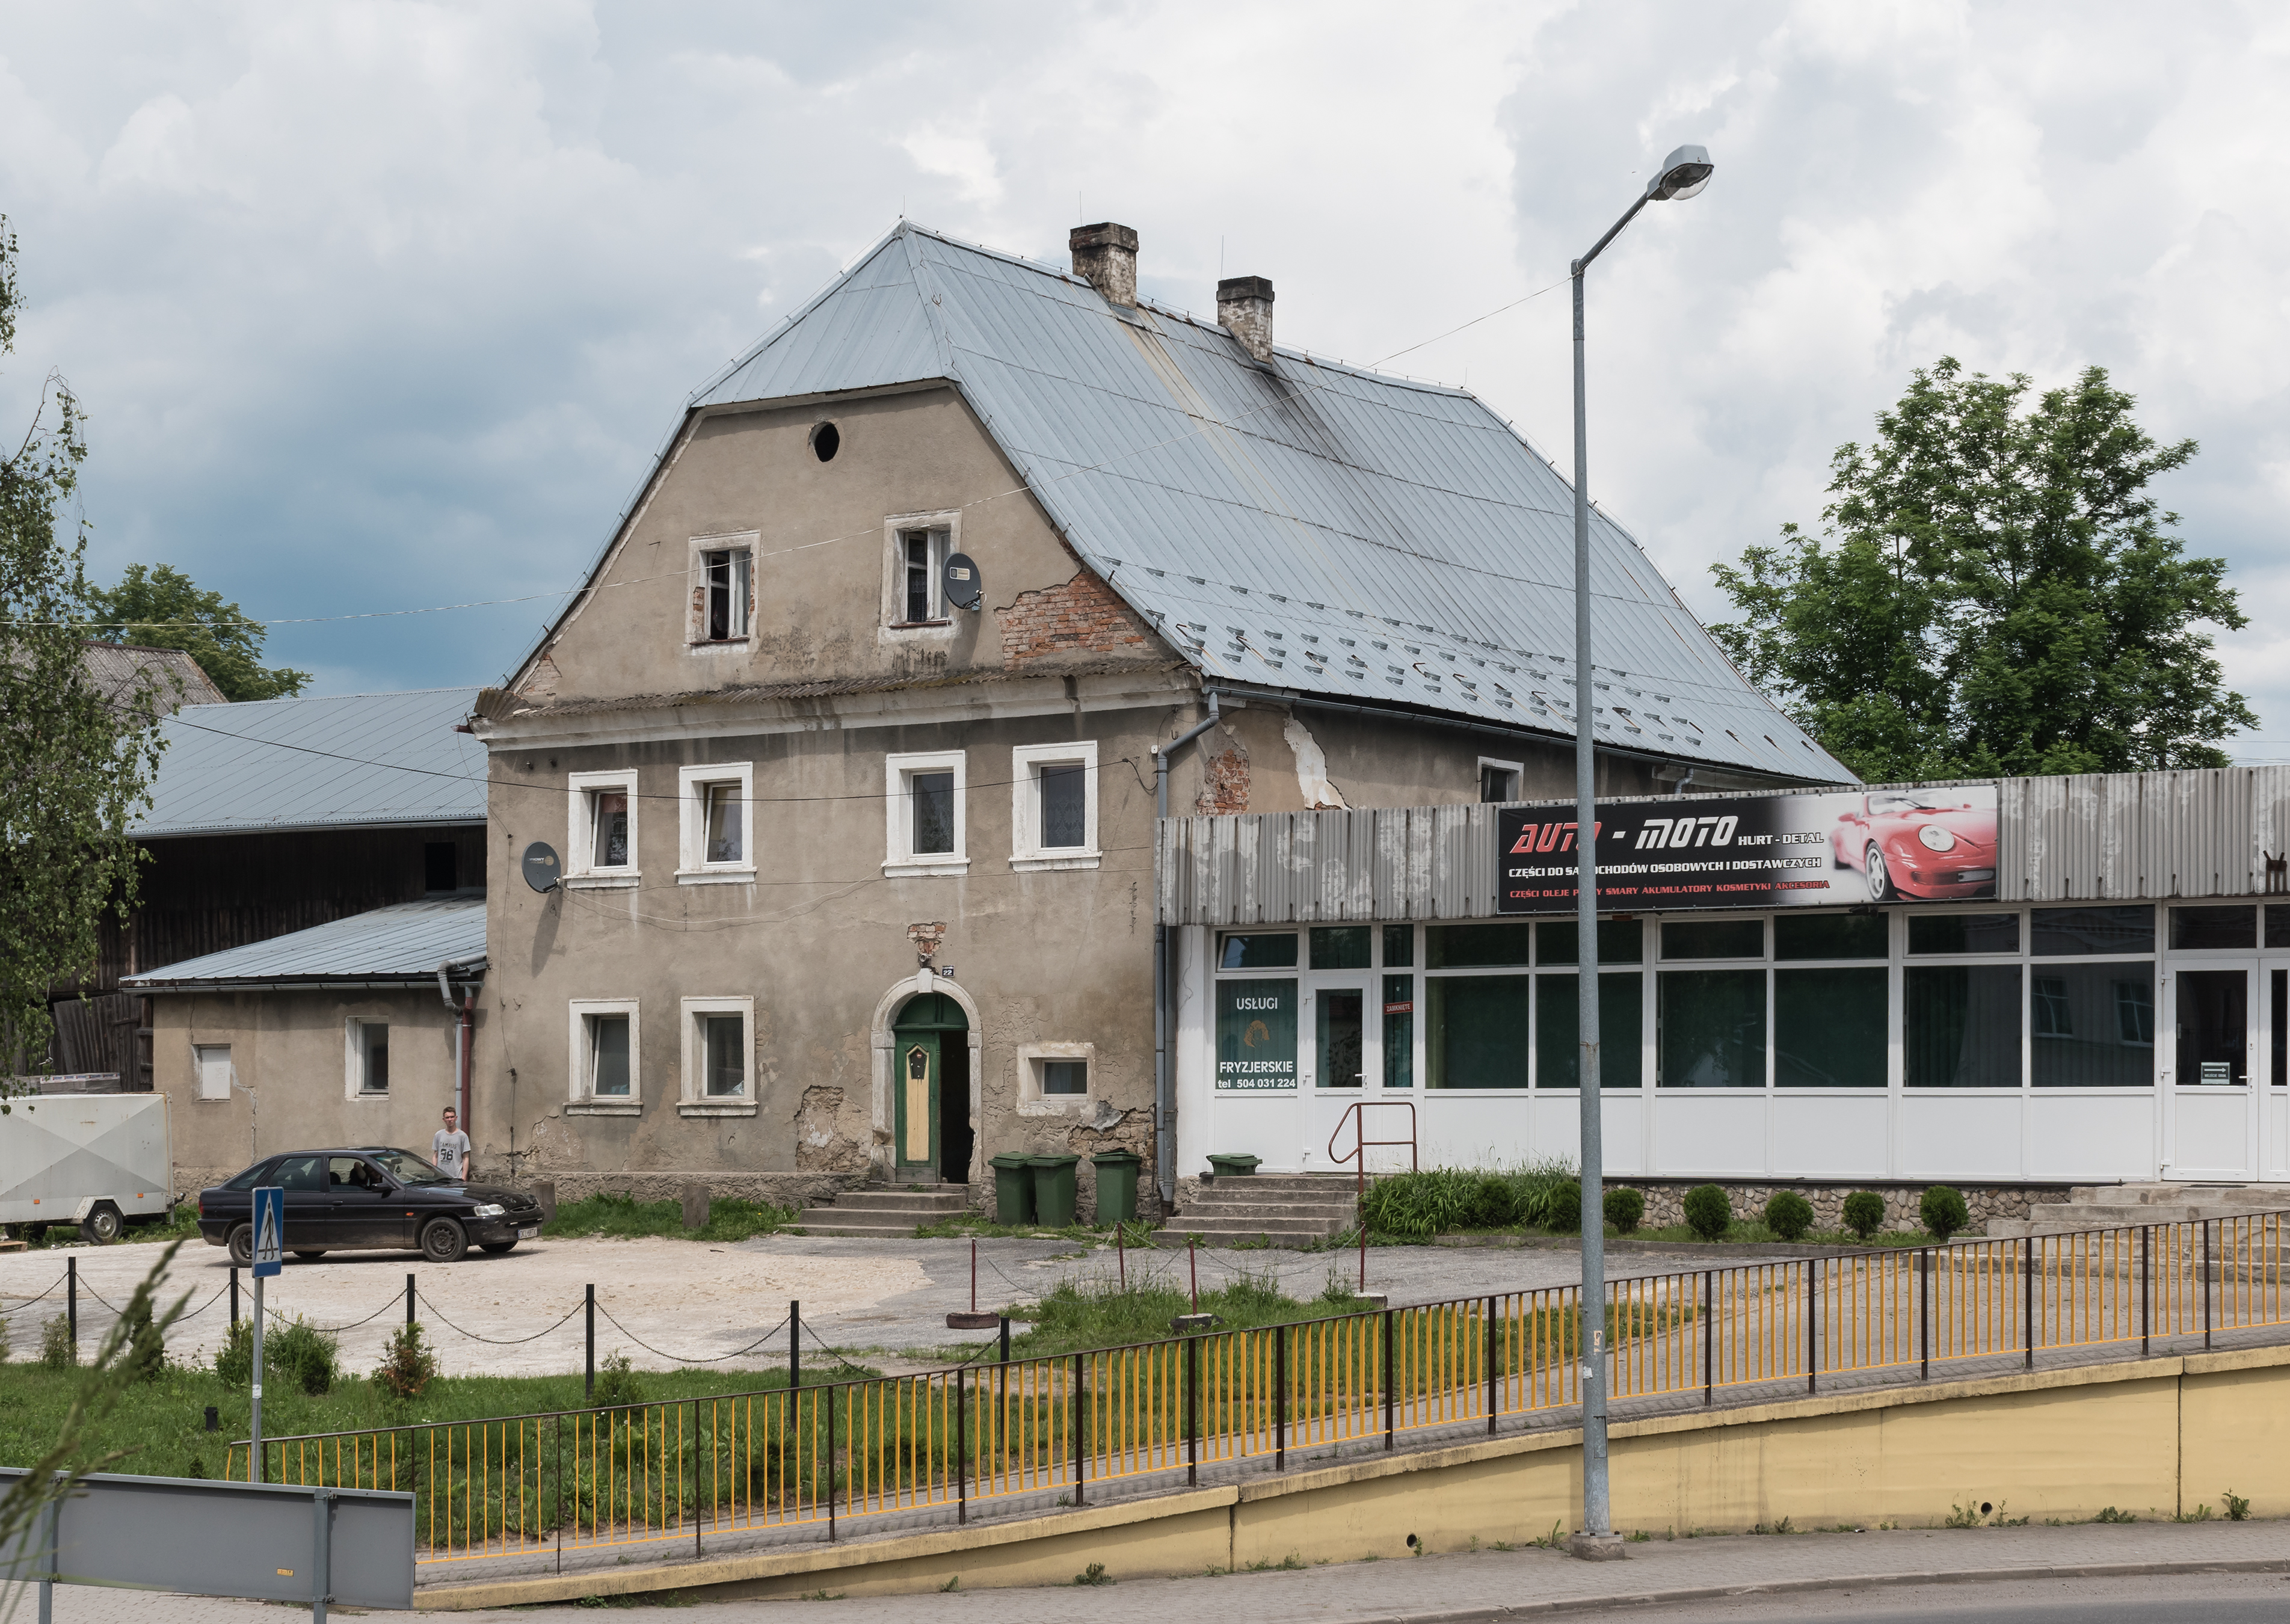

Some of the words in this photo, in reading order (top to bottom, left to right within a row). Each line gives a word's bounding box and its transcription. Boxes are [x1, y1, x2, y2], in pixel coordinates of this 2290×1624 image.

[1634, 816, 1738, 849] MOTO
[1738, 835, 1773, 846] HURT
[1782, 832, 1824, 844] DETAL
[1509, 866, 1545, 879] CZĘŚCI
[1547, 867, 1563, 876] DO
[1565, 863, 1649, 876] SACHODÓW
[1650, 861, 1723, 873] OSOBOWYCH
[1726, 861, 1730, 870] I
[1732, 858, 1821, 871] DOSTAWCZYCH
[1510, 888, 1539, 899] CZĘŚCI
[1642, 885, 1713, 894] AKUMULATORY
[1717, 882, 1771, 892] KOSMETYKI
[1774, 880, 1830, 890] AKCESORIA
[1236, 997, 1278, 1010] USŁUGI
[1386, 1003, 1411, 1012] ZAMKNIĘTE
[1220, 1061, 1293, 1073] FRYZJERSKIE
[1217, 1079, 1231, 1088] tel
[1237, 1078, 1255, 1088] 504
[1257, 1078, 1275, 1088] 031
[1277, 1078, 1296, 1087] 224
